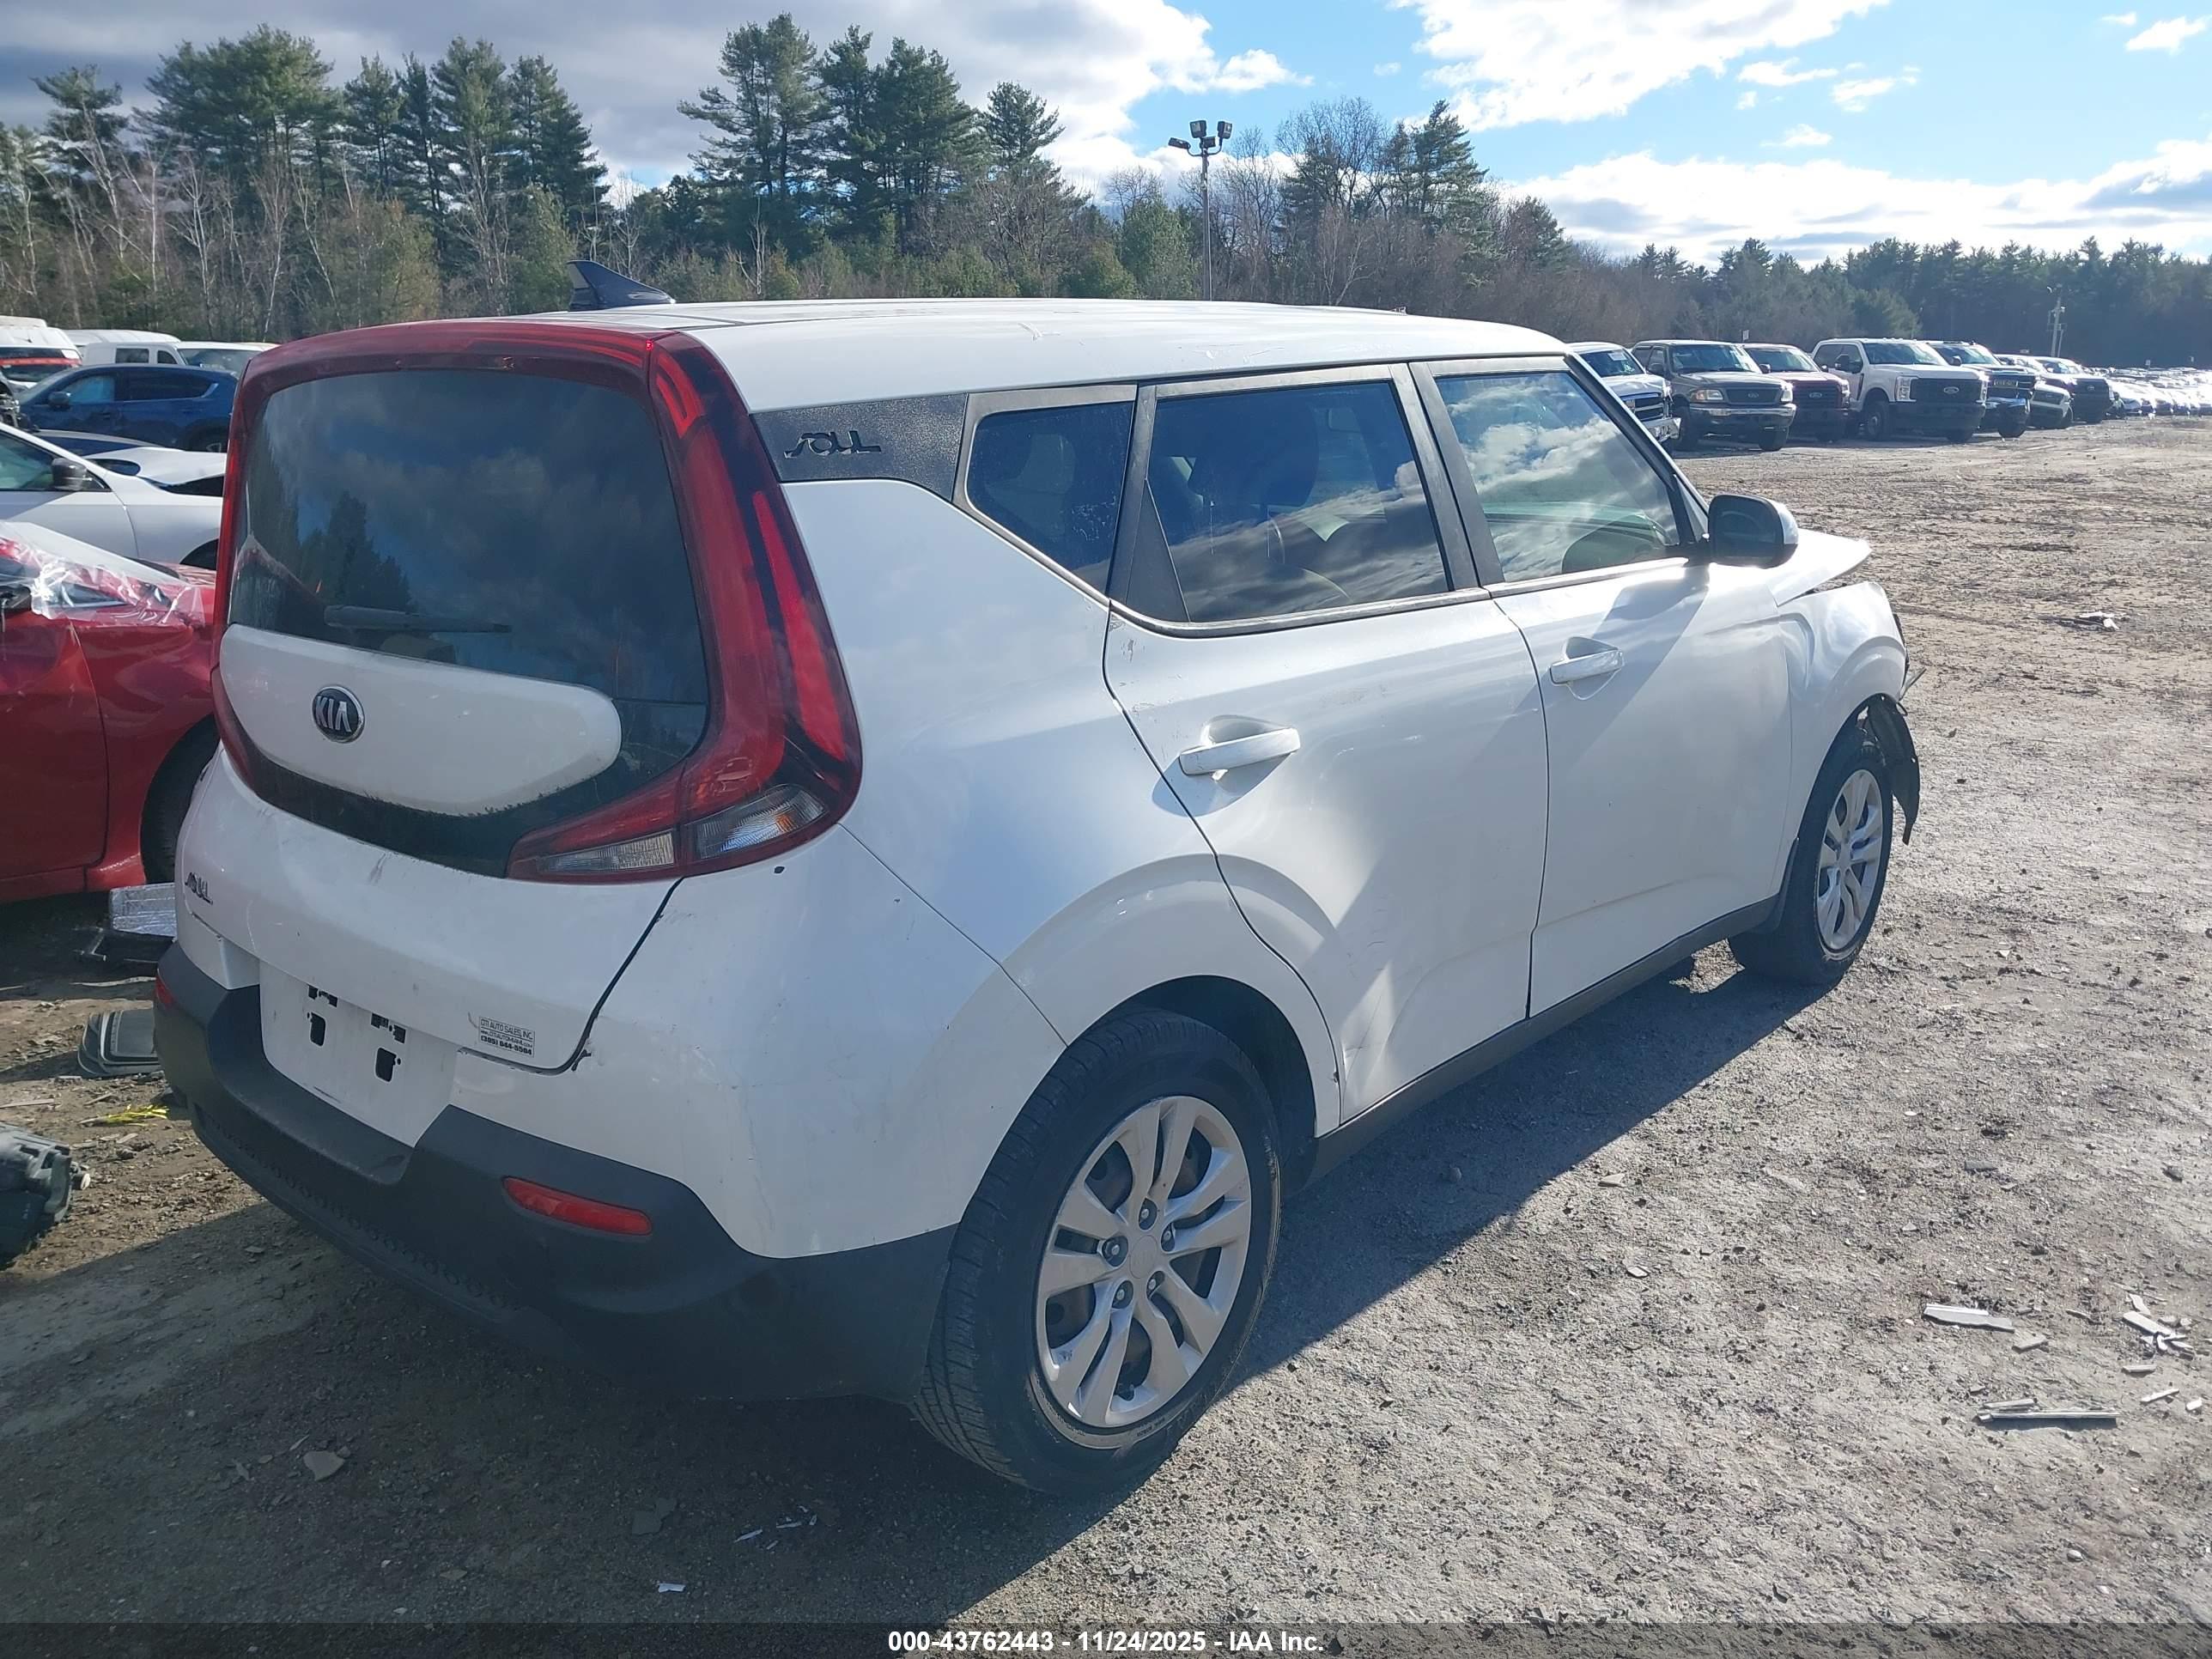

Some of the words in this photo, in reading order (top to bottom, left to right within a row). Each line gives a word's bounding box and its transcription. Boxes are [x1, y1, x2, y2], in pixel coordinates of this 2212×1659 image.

[784, 430, 882, 459] SOUL
[315, 696, 352, 732] KIA
[489, 1022, 504, 1032] AUTO
